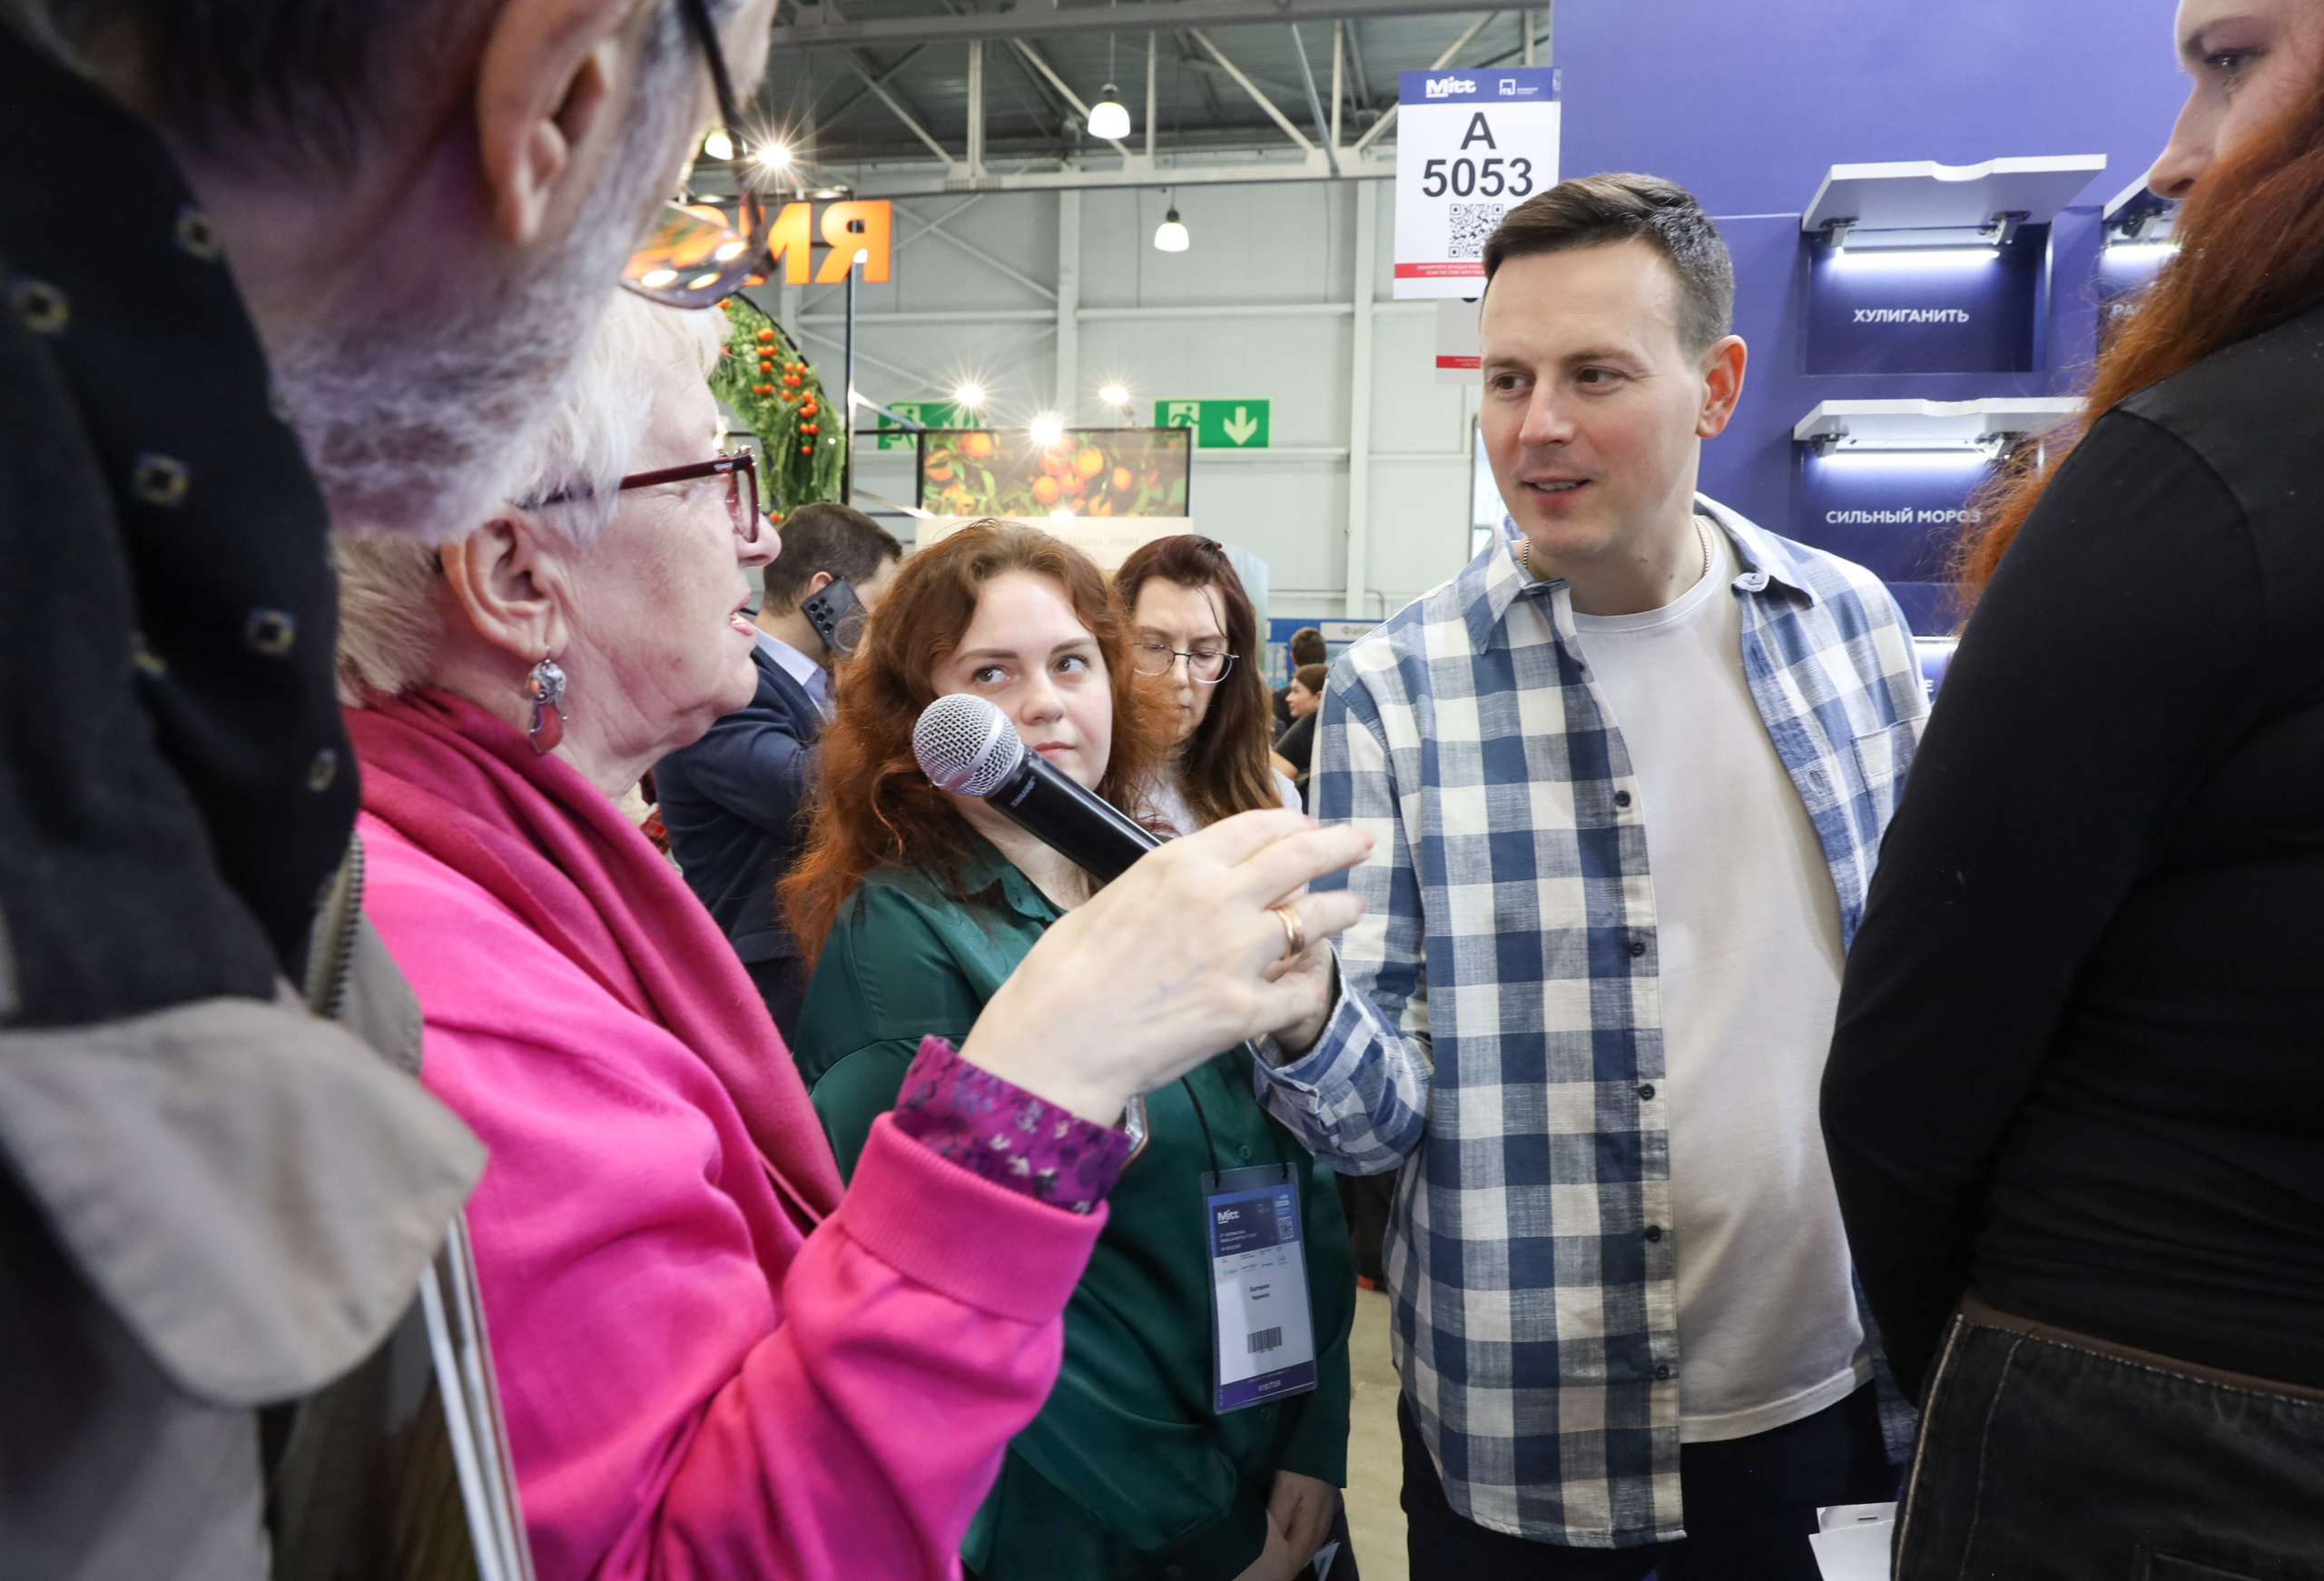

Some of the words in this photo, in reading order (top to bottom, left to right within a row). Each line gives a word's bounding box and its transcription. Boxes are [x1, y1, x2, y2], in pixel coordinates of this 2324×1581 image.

[1425, 76, 1477, 98] Mitt
[1460, 112, 1497, 150] A
[1423, 158, 1533, 197] 5053
[1853, 309, 1969, 322] ХУЛИГАНИТЬ
[1827, 508, 1913, 523] СИЛЬНЫЙ
[1918, 509, 1982, 524] МОРОЗ
